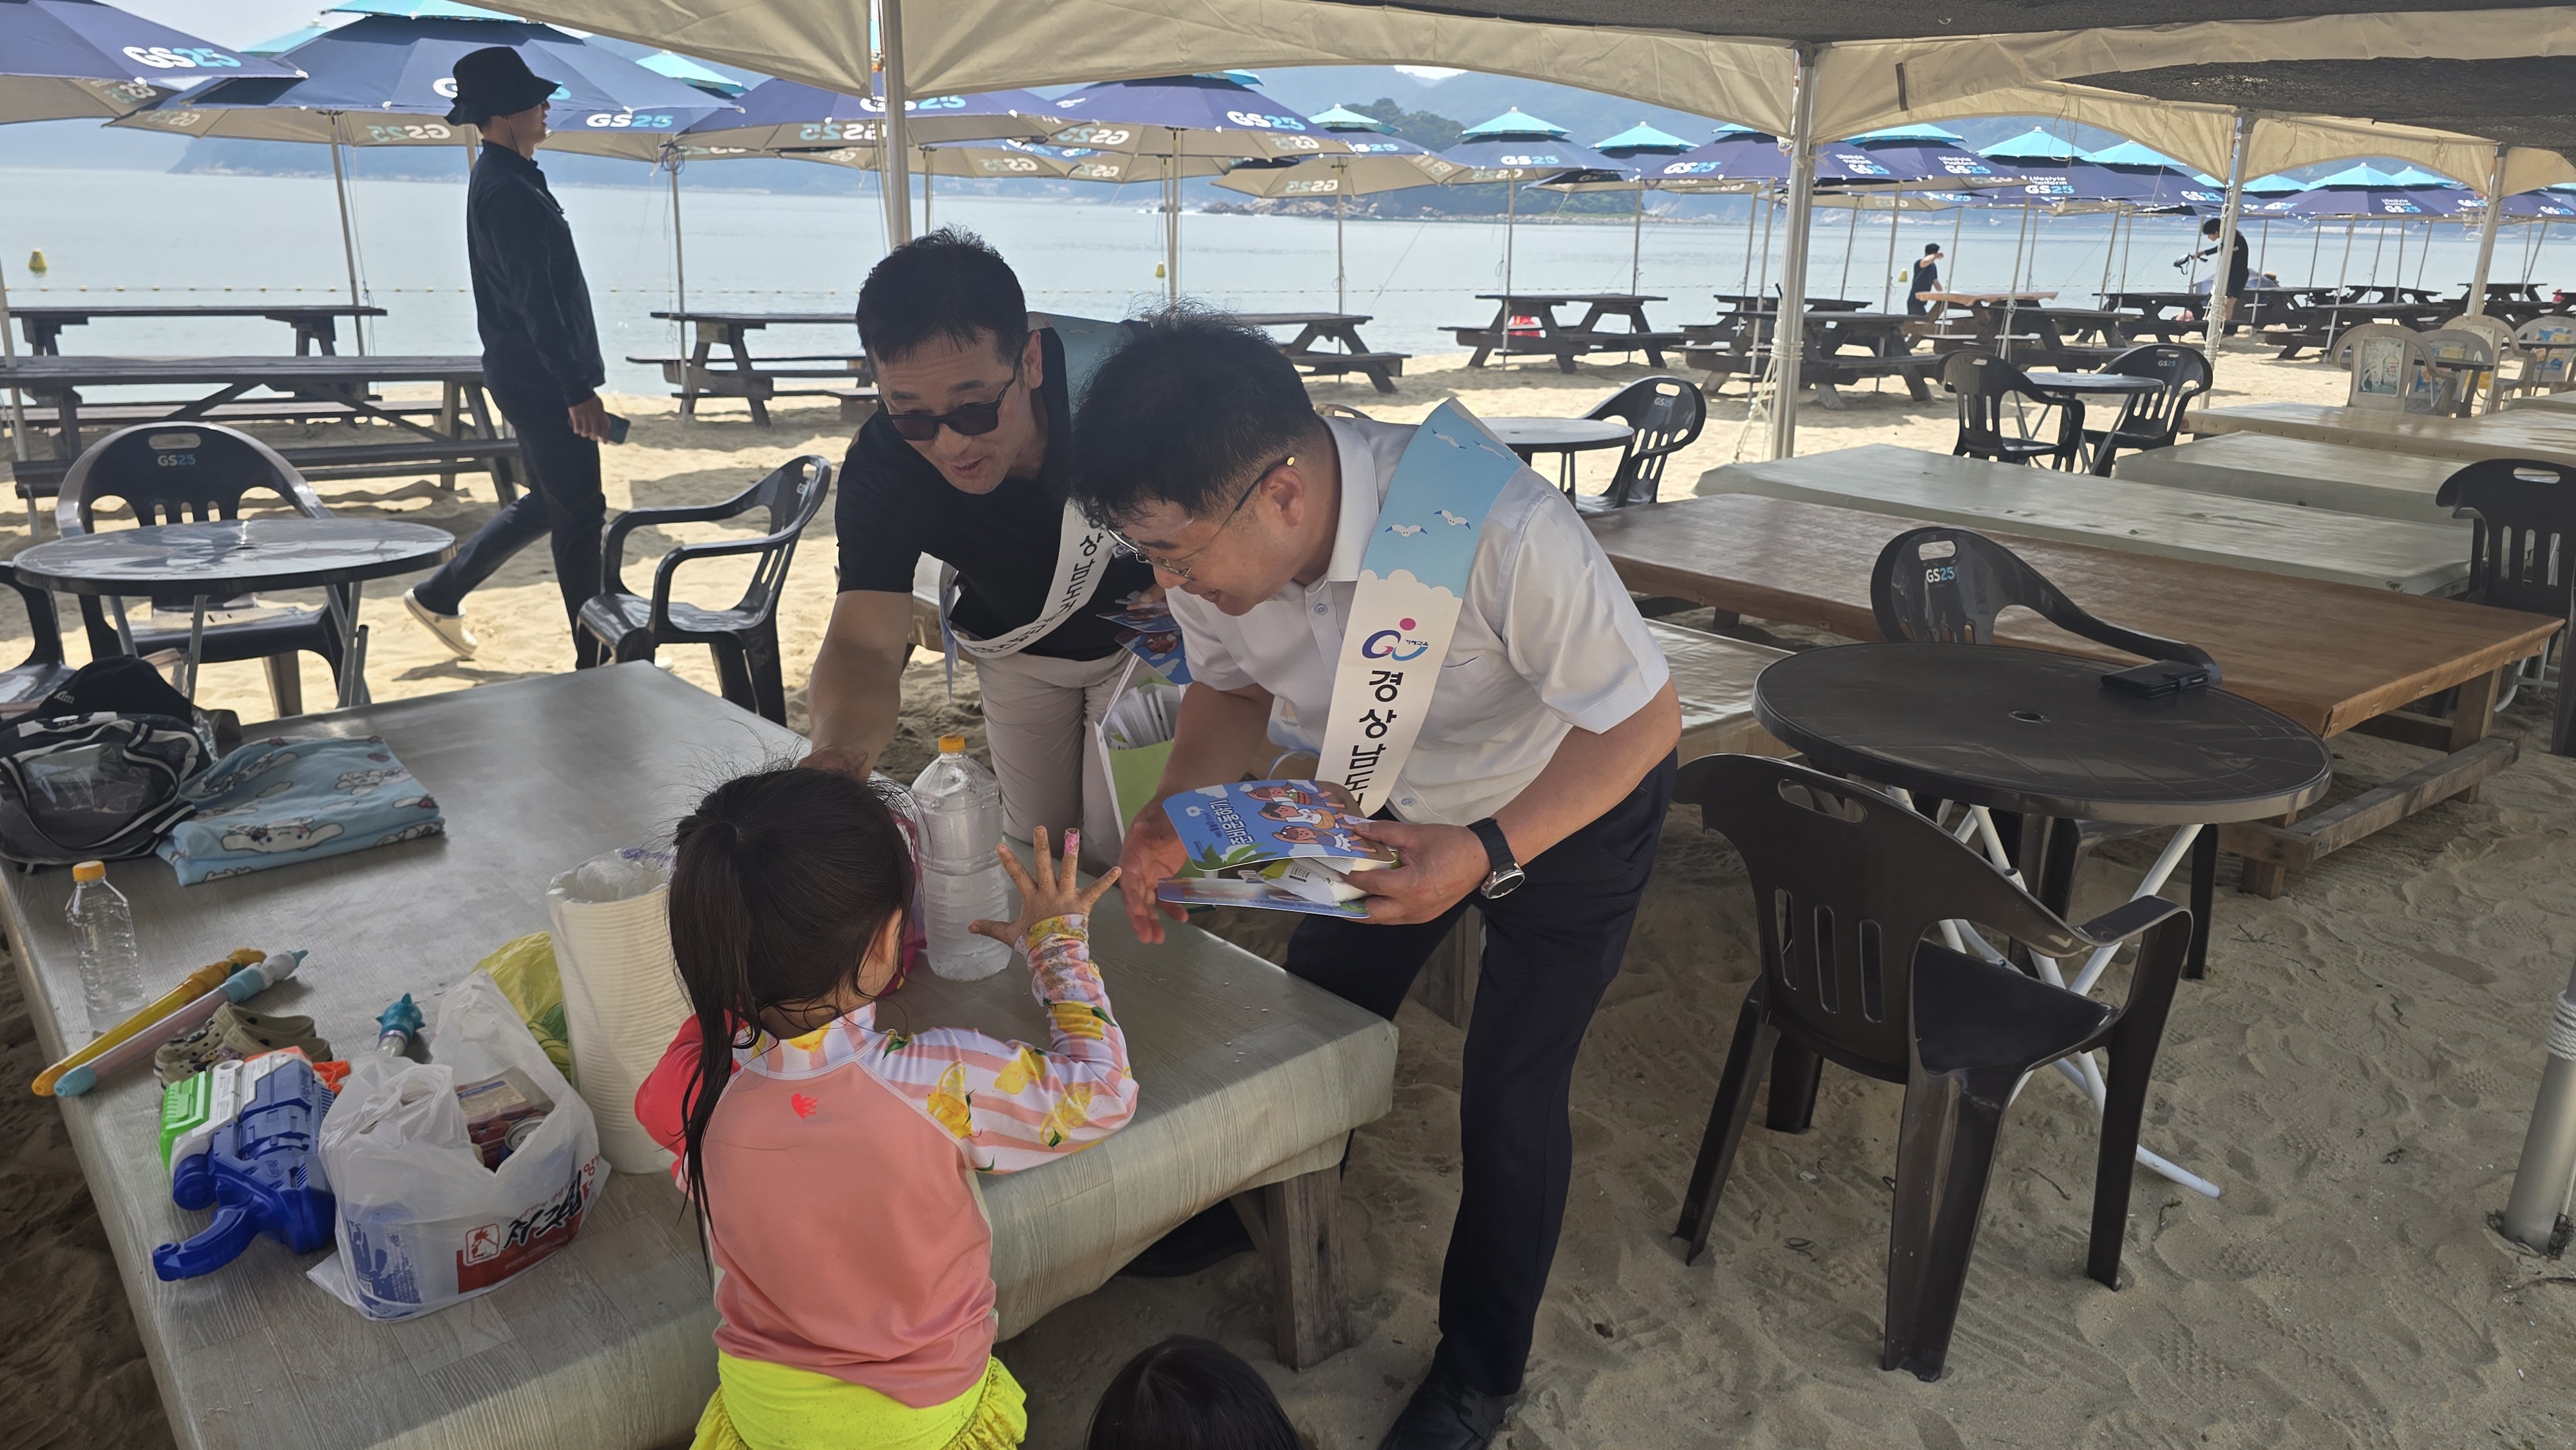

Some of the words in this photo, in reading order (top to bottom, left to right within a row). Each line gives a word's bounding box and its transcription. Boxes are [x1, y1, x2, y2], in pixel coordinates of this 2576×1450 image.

[123, 46, 242, 68] GS25
[585, 113, 674, 128] GS25
[1226, 111, 1306, 131] GS25
[1501, 155, 1560, 165] GS25
[2025, 185, 2075, 194] GS25
[157, 453, 196, 467] GS25
[1926, 566, 1956, 583] GS25
[1209, 799, 1255, 845] 준비운동하기
